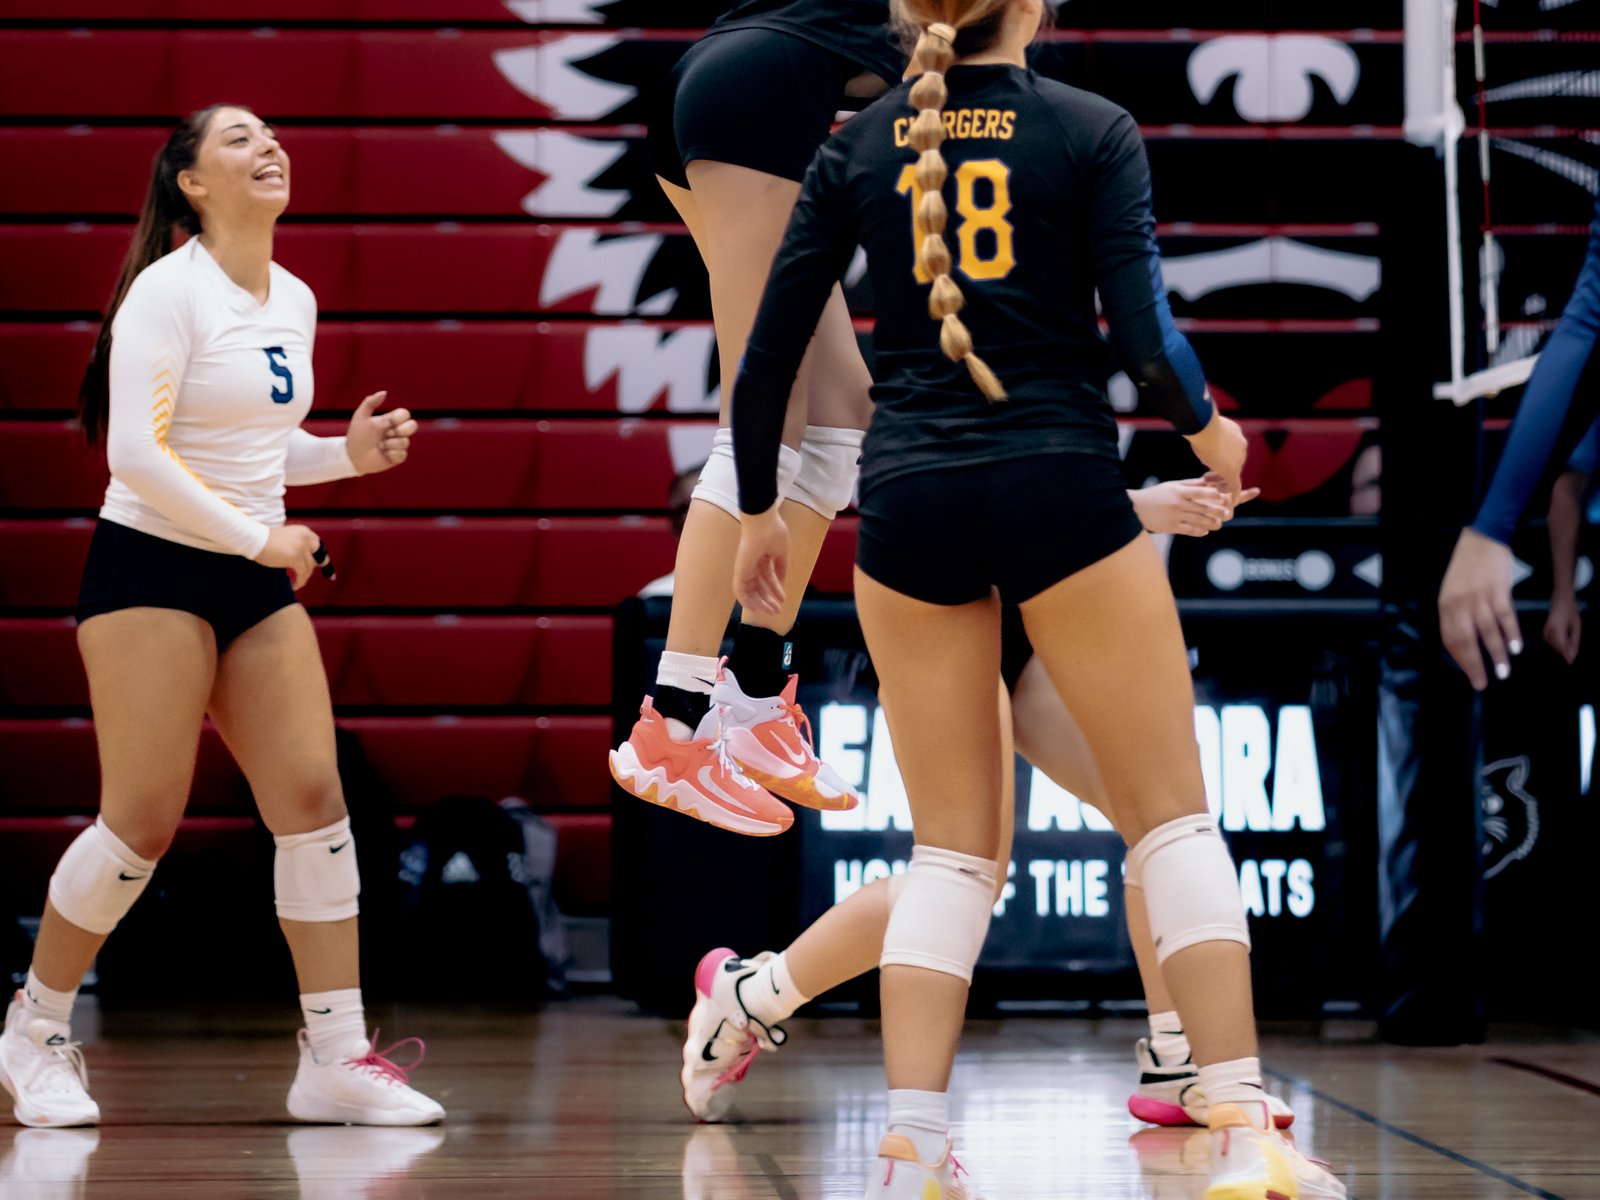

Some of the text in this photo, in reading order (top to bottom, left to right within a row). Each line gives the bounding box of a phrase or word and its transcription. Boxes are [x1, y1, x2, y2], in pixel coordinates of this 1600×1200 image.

[893, 108, 1017, 147] CRGERS
[895, 158, 1017, 285] 18
[262, 346, 294, 404] 5
[819, 703, 915, 832] EA
[1028, 858, 1110, 917] THE
